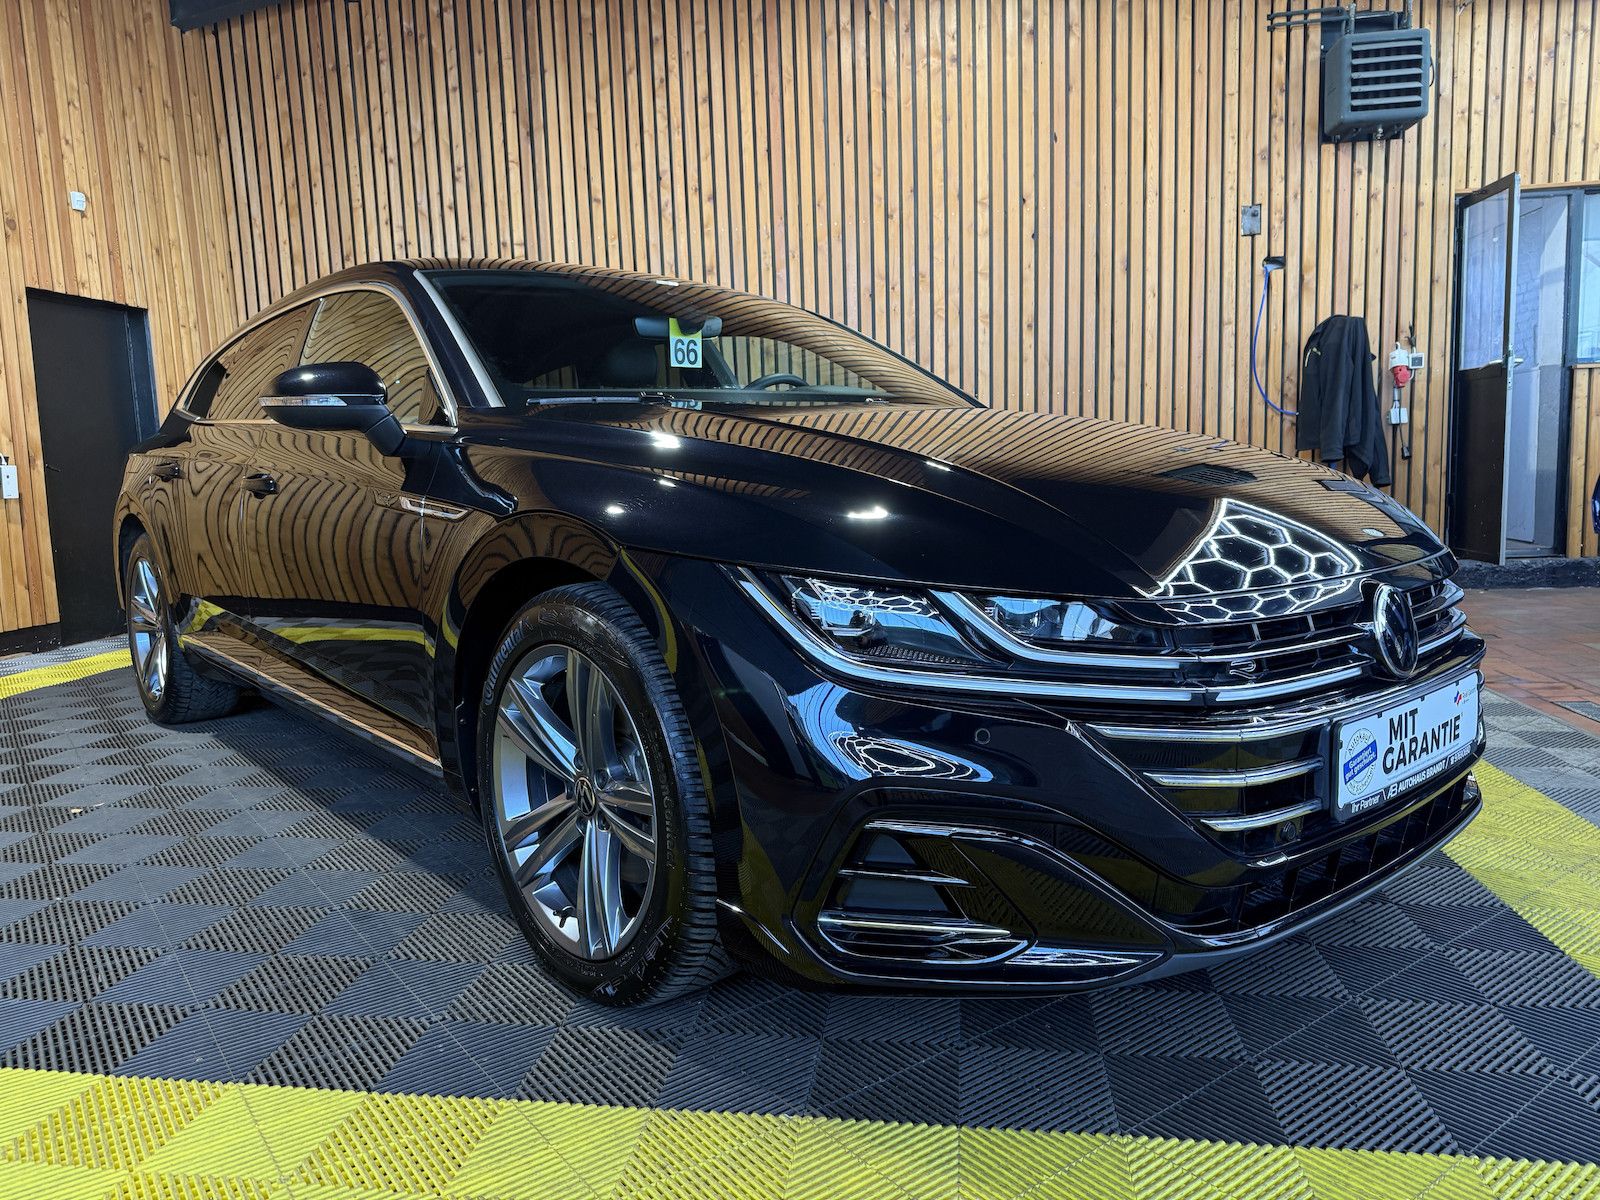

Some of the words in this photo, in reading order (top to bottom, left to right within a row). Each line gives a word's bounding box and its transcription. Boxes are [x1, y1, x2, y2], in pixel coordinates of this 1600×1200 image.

[674, 338, 699, 366] 66
[1382, 714, 1461, 775] GARANTIE
[1389, 707, 1419, 746] MIT
[1351, 802, 1361, 814] Ihr
[1360, 793, 1381, 811] Partner
[1397, 769, 1427, 793] AUTOHAUS
[1425, 758, 1447, 779] BRANDT
